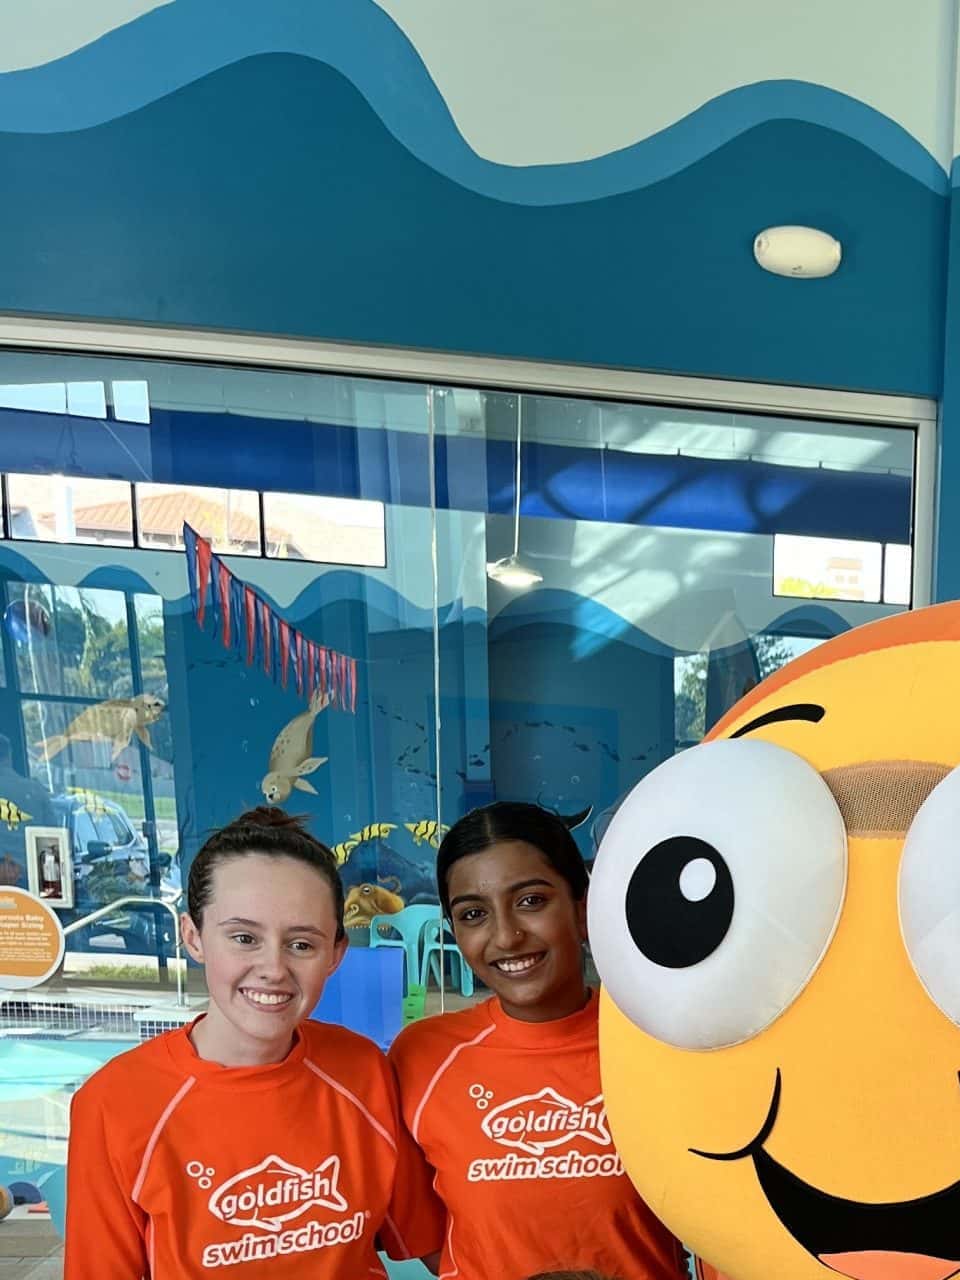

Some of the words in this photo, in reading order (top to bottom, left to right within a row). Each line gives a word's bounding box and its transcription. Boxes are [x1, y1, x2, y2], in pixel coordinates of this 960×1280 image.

[492, 1107, 594, 1138] goldfish
[469, 1154, 537, 1180] swim
[221, 1173, 330, 1218] goldfish
[204, 1235, 276, 1265] swim
[280, 1212, 364, 1252] school
